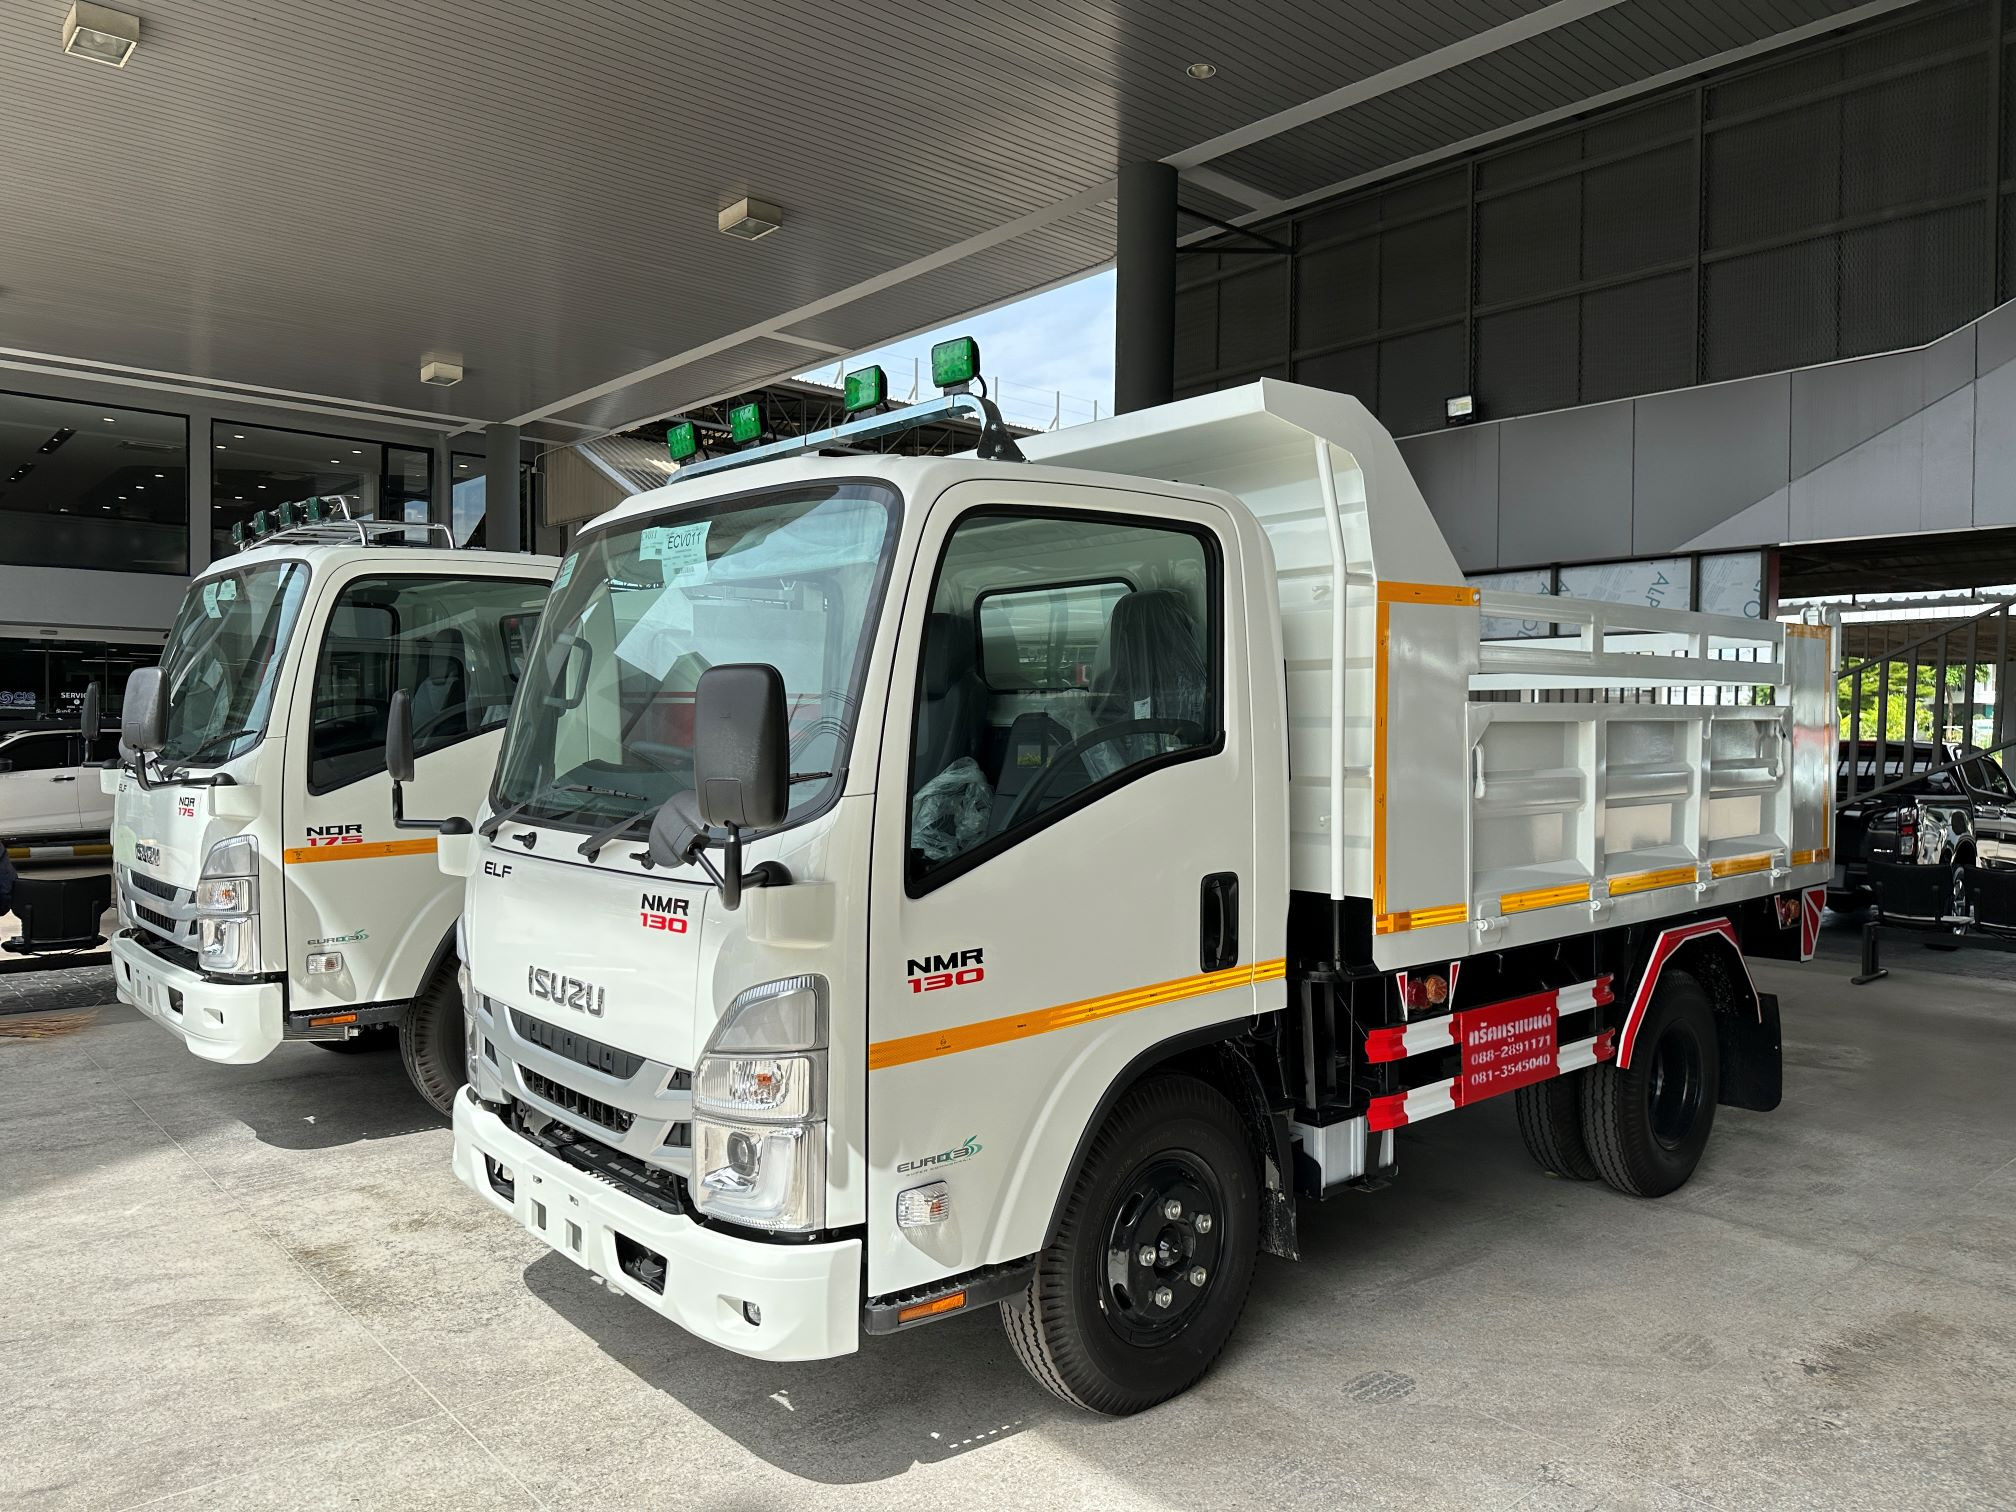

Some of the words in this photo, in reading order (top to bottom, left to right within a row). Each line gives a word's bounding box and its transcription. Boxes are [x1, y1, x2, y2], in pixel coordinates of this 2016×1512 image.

[667, 532, 702, 550] ECV011
[178, 796, 196, 807] NQR
[178, 807, 195, 817] 175
[306, 824, 363, 836] NQR
[307, 835, 364, 846] 175
[484, 861, 513, 878] ELF
[640, 893, 690, 917] NMR
[640, 912, 688, 934] 130
[907, 947, 984, 976] NMR
[907, 967, 985, 993] 130
[528, 964, 606, 1019] ISUZU
[1471, 1035, 1551, 1066] 088-2891171
[1471, 1053, 1551, 1086] 081-3545040
